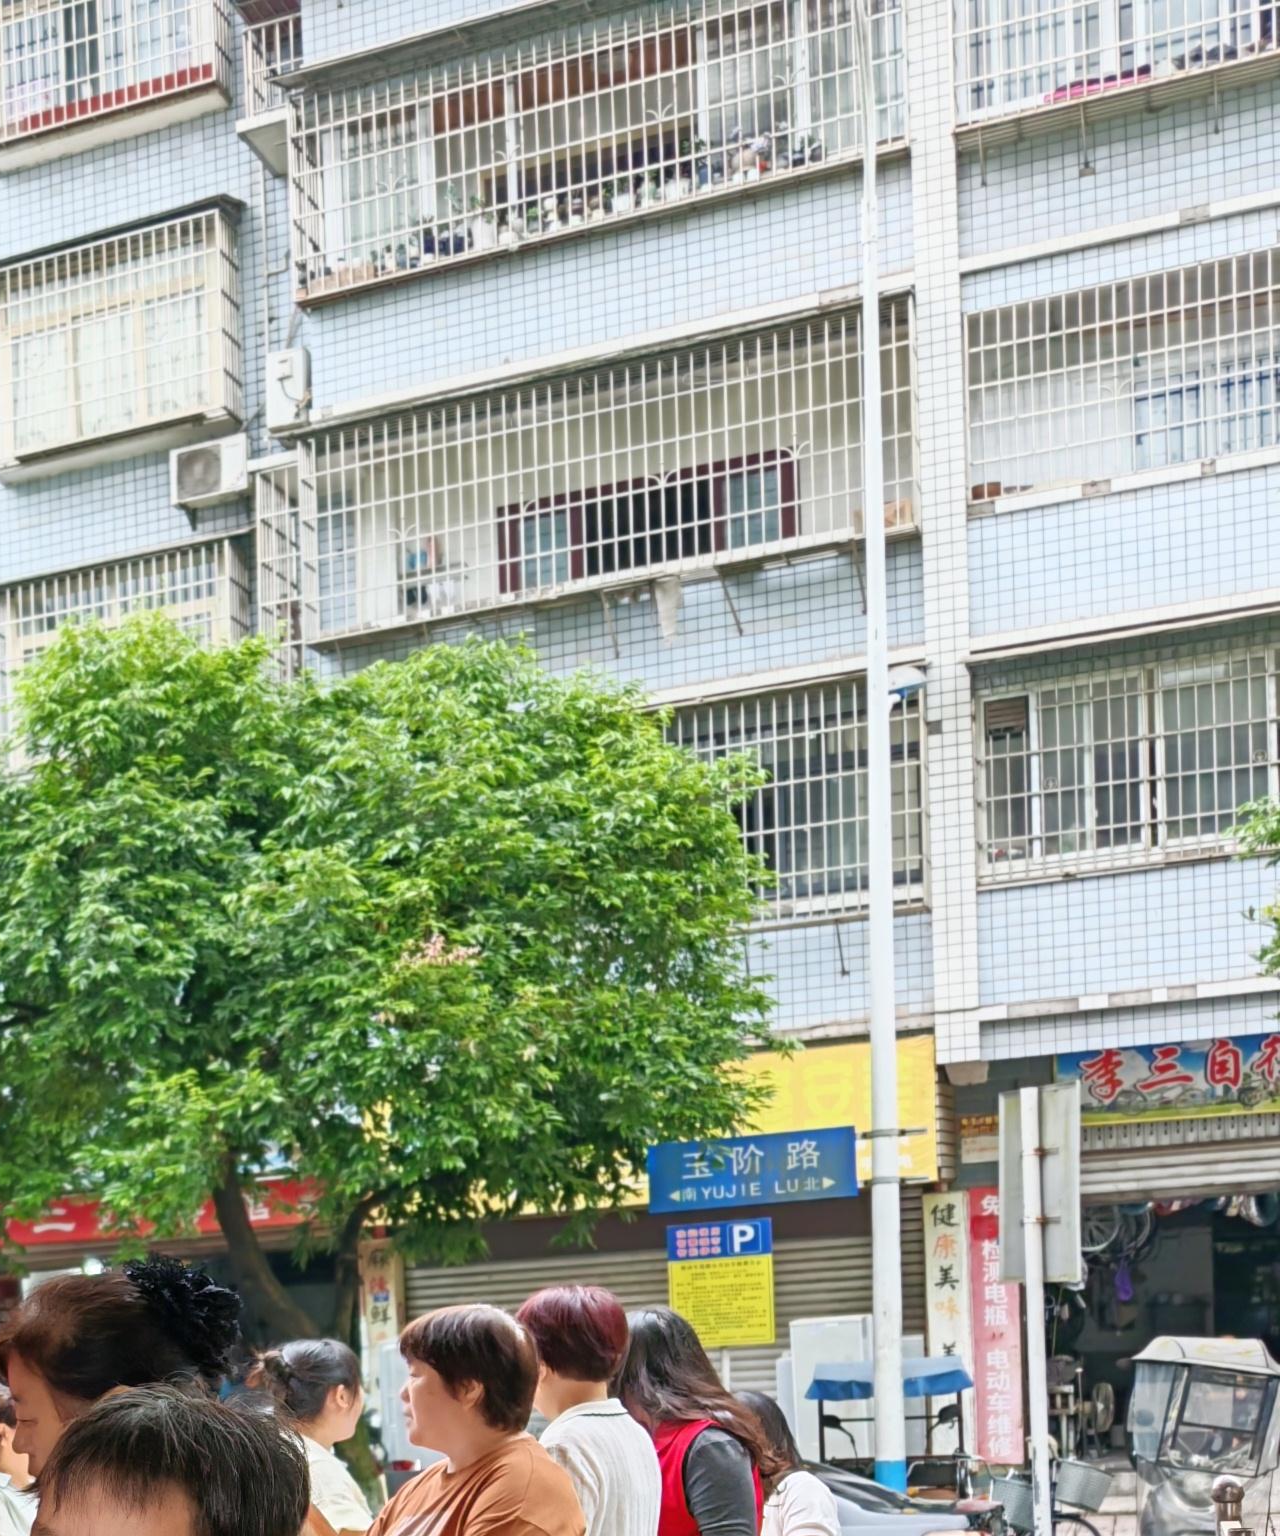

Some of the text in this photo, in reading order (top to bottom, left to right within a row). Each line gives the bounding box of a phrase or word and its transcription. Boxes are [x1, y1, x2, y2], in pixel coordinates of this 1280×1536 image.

[682, 1139, 821, 1179] 玉阶路
[682, 1177, 821, 1202] 南 YUJIE LU 北
[733, 1224, 755, 1253] P
[986, 1349, 1011, 1457] 电动车维修
